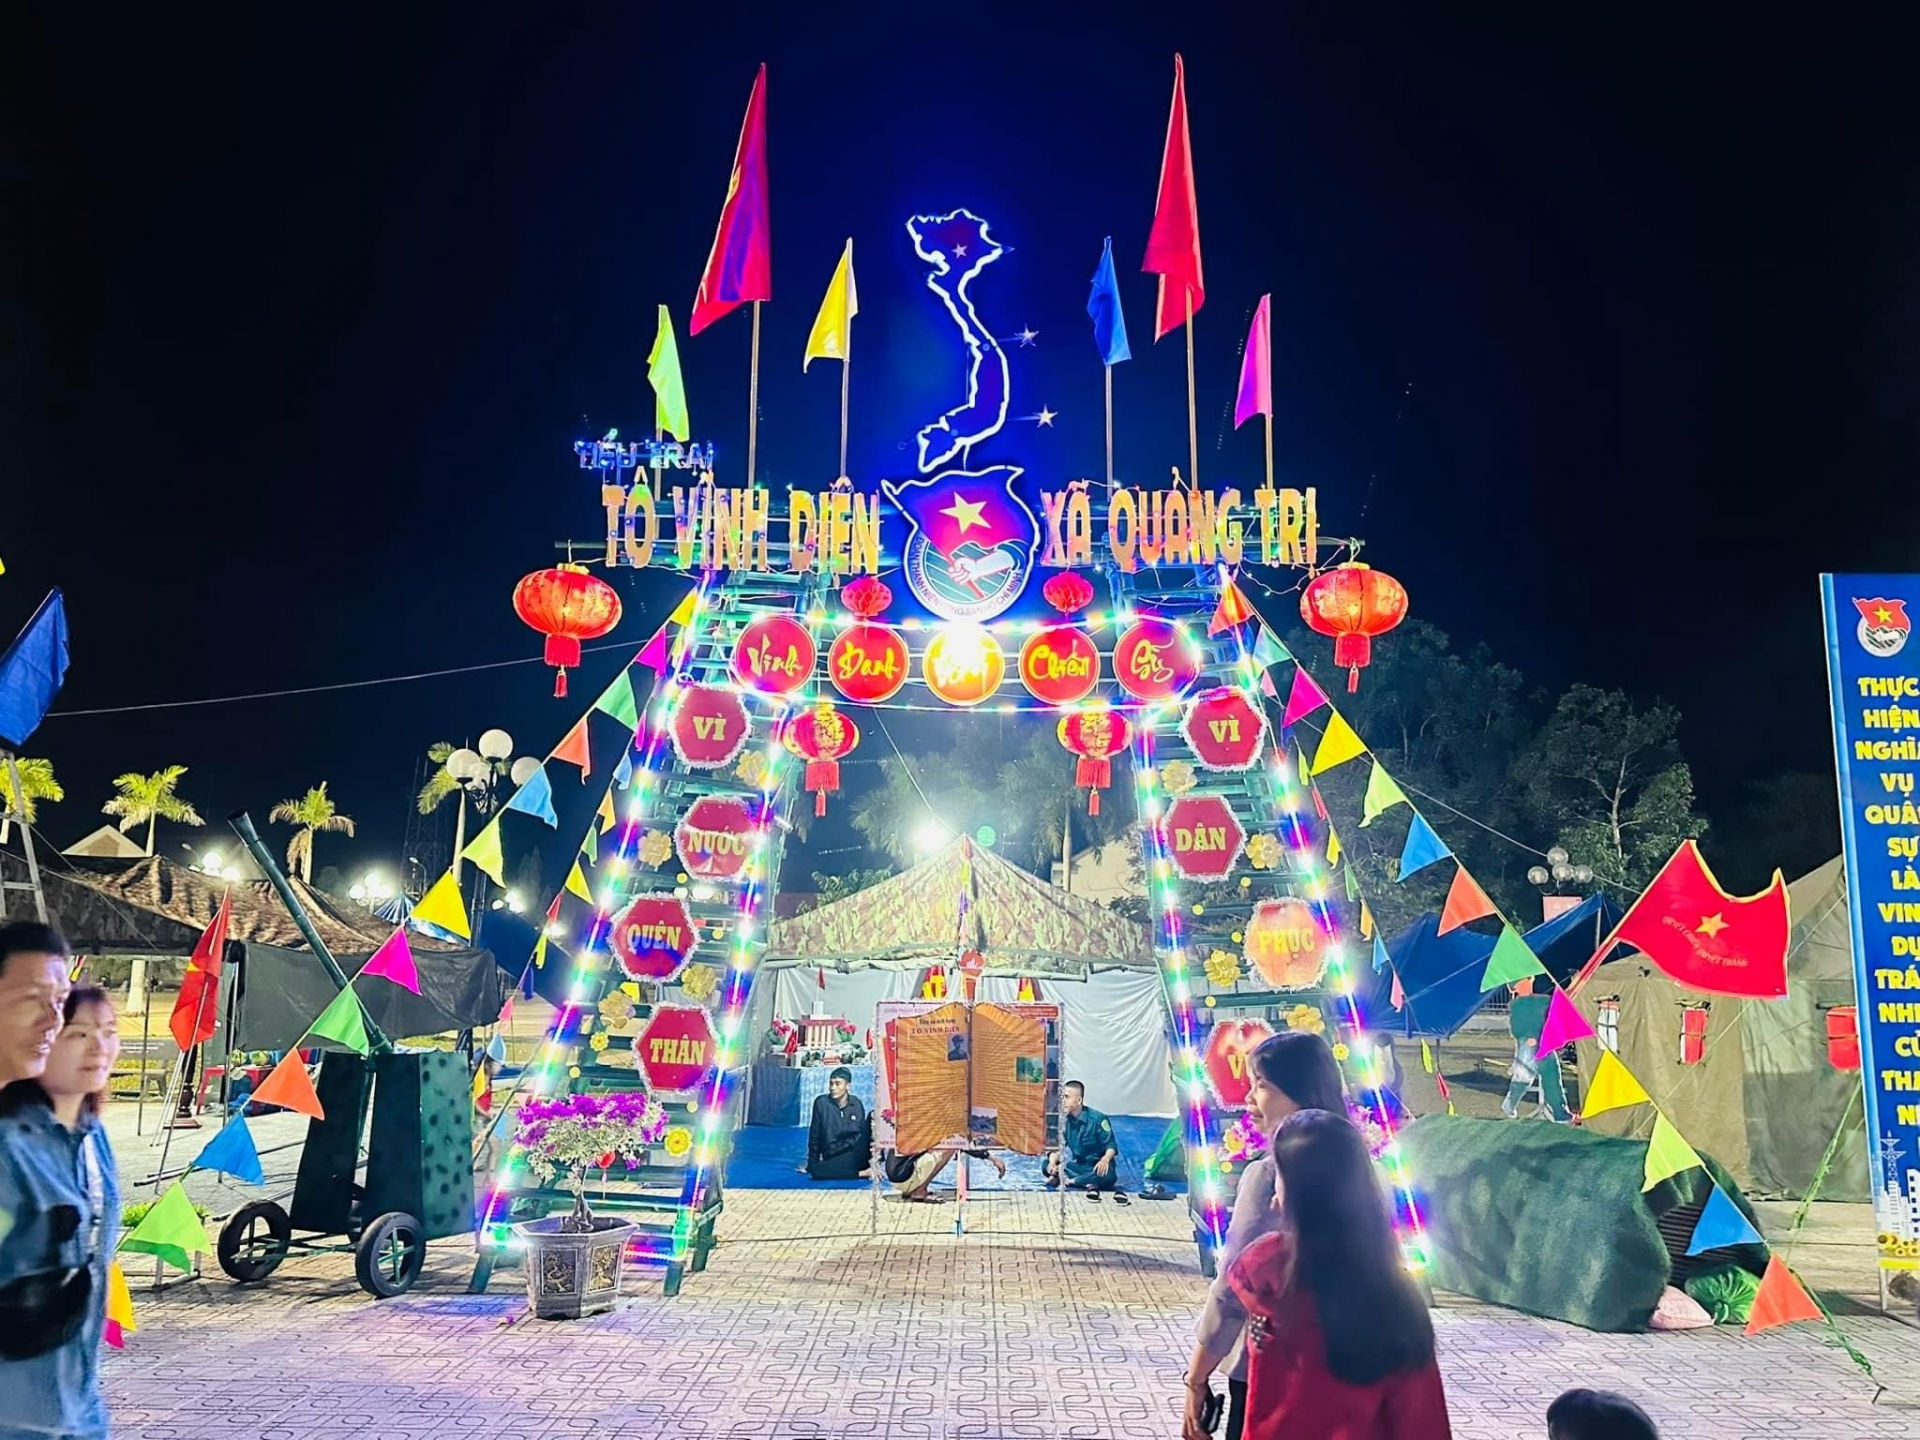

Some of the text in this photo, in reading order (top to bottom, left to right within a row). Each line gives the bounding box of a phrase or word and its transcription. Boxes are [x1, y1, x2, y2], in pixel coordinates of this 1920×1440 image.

[602, 466, 656, 568] TÔ
[1040, 466, 1317, 578] XÃ QUẢNG TRỊ
[746, 634, 804, 677] Vinh
[838, 640, 900, 680] Danh
[1028, 639, 1090, 680] Chiến
[1857, 675, 1920, 702] THỰC
[693, 712, 727, 741] VÌ
[1208, 714, 1241, 743] VÌ
[1863, 704, 1920, 734] HIỆN
[1855, 735, 1920, 760] NGHĨ
[1880, 773, 1915, 798] VỤ
[1864, 800, 1920, 825] QUÂ
[1174, 822, 1227, 851] DÂN
[1890, 864, 1920, 890] LÀ
[627, 920, 682, 951] QUÊN
[1258, 926, 1316, 959] PHỤC
[650, 1034, 707, 1065] THÂN
[1226, 1053, 1246, 1080] V
